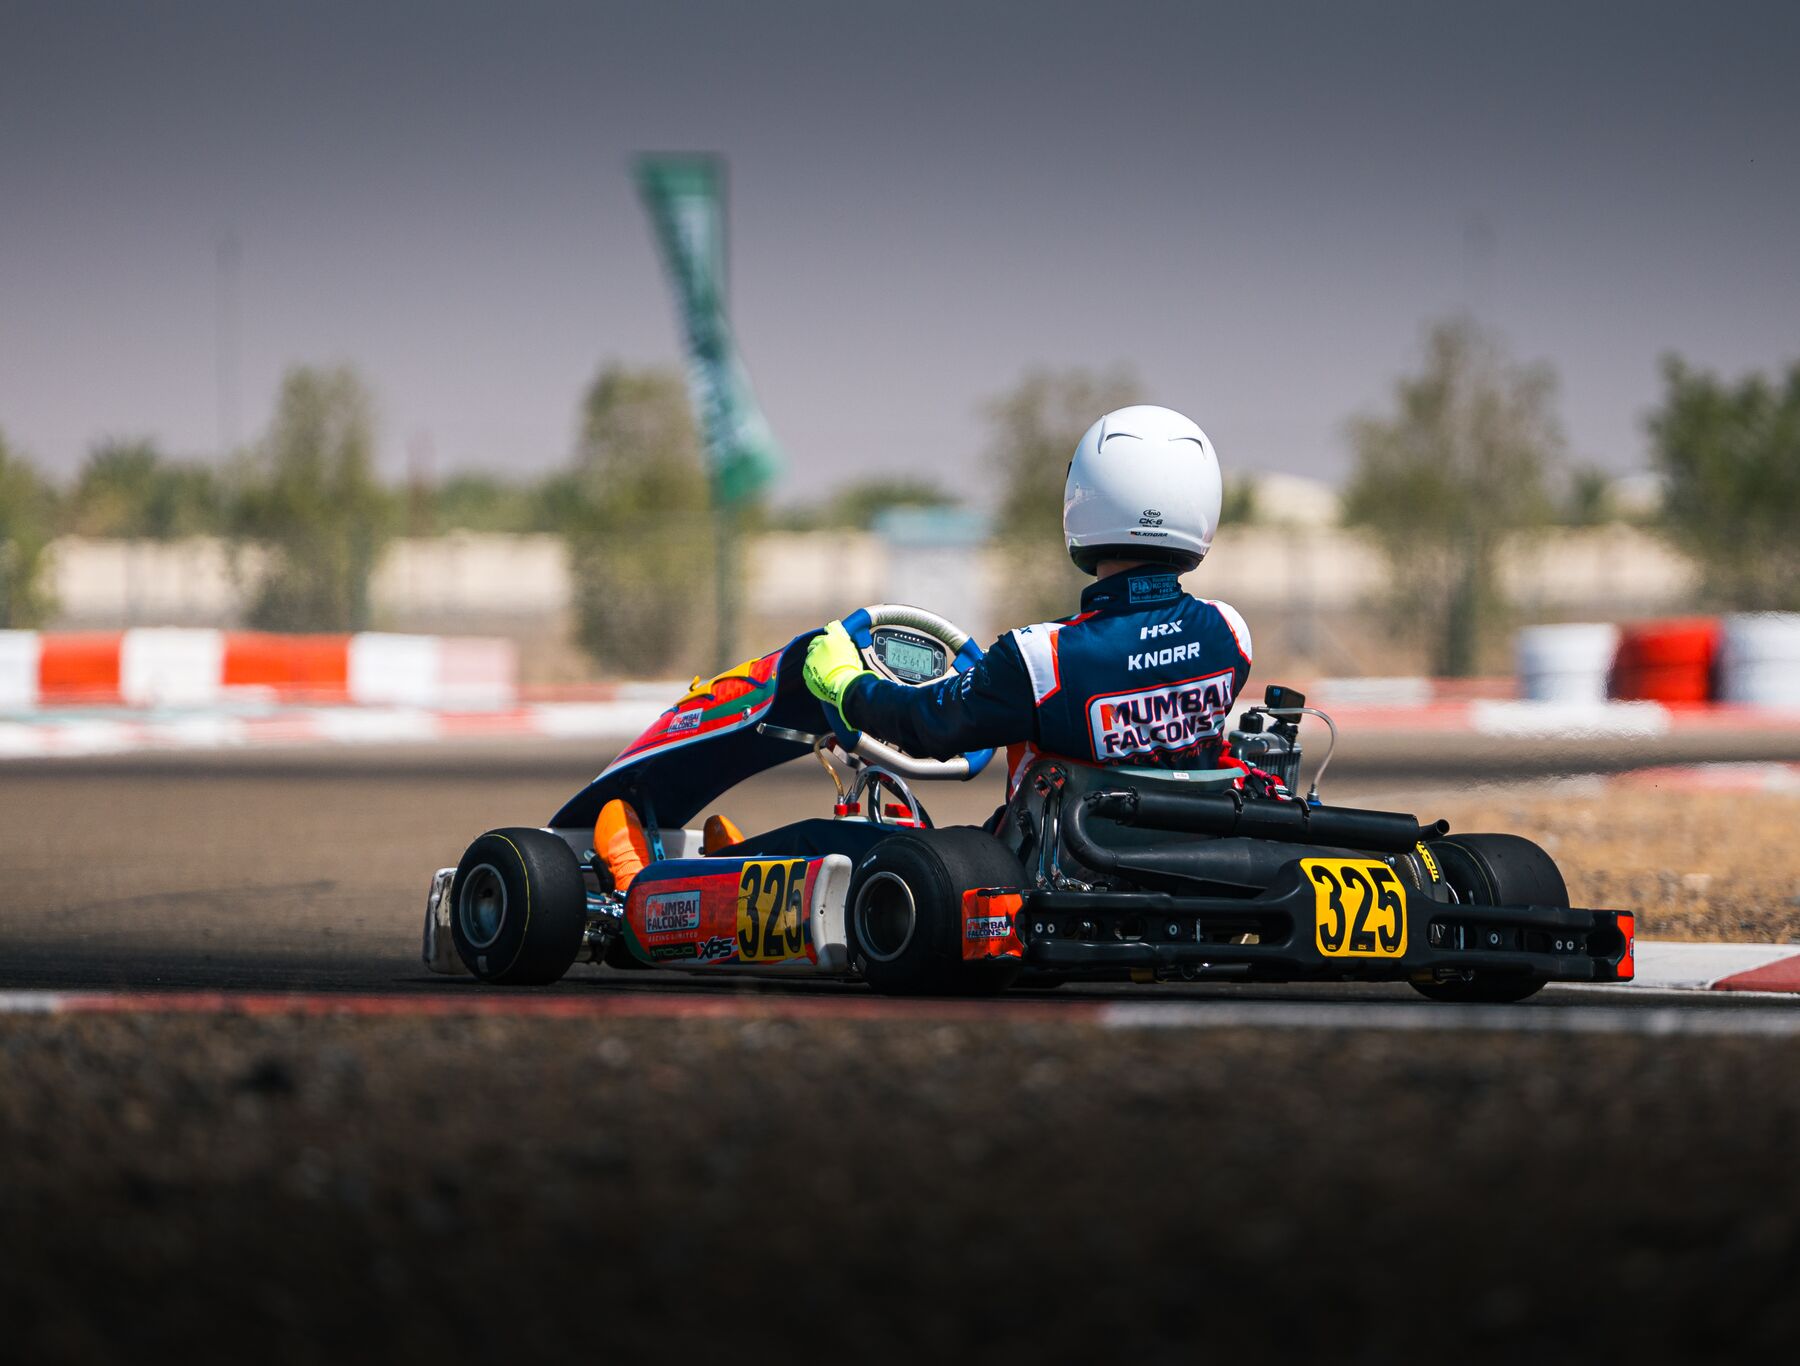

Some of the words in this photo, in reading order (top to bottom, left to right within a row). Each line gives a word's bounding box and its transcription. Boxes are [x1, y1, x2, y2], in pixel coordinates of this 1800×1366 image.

[1140, 620, 1182, 640] HRX
[1128, 642, 1200, 671] KNORR
[1100, 680, 1230, 731] MUMBAI
[1103, 714, 1212, 753] FALCONS
[647, 914, 689, 930] FALCONS
[648, 900, 696, 918] MUMBAI
[739, 862, 808, 958] 325
[1311, 865, 1403, 953] 325
[699, 937, 733, 959] XPS
